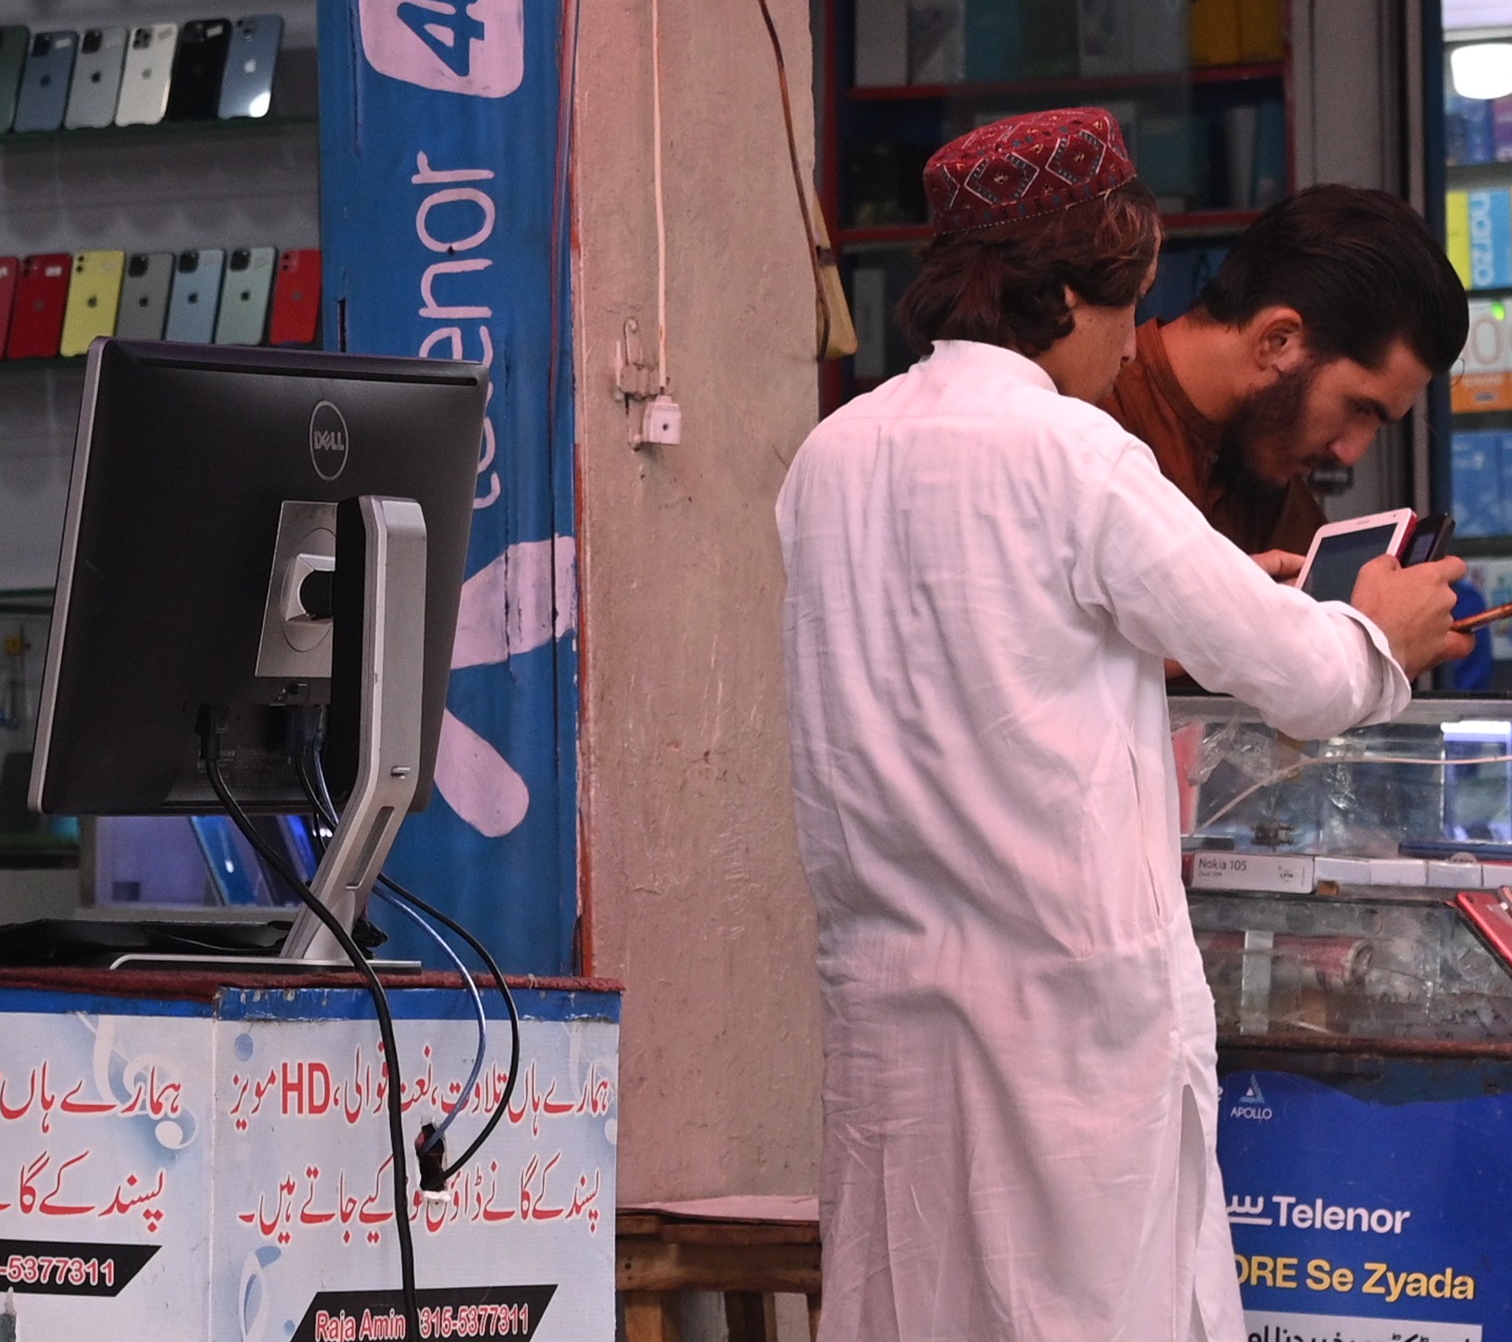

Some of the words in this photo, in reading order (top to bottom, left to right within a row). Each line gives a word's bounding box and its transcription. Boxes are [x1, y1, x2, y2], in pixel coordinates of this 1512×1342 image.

[313, 428, 346, 452] DELL
[1198, 858, 1226, 871] Nokia
[1228, 859, 1248, 872] 105
[59, 1063, 183, 1120] ہمارے
[230, 1067, 278, 1132] مویز
[281, 1062, 332, 1116] HD
[543, 1060, 610, 1117] ہمارے
[1230, 1106, 1273, 1121] APOLLO
[97, 1167, 168, 1233] پسند
[299, 1165, 359, 1245] جاتے
[563, 1167, 603, 1235] پسند
[1272, 1195, 1411, 1234] Telenor
[1234, 1253, 1299, 1289] ORE
[1306, 1258, 1354, 1292] Se
[1361, 1261, 1475, 1303] Zyada
[359, 1308, 406, 1341] Amin
[417, 1302, 530, 1341] 315-5377311
